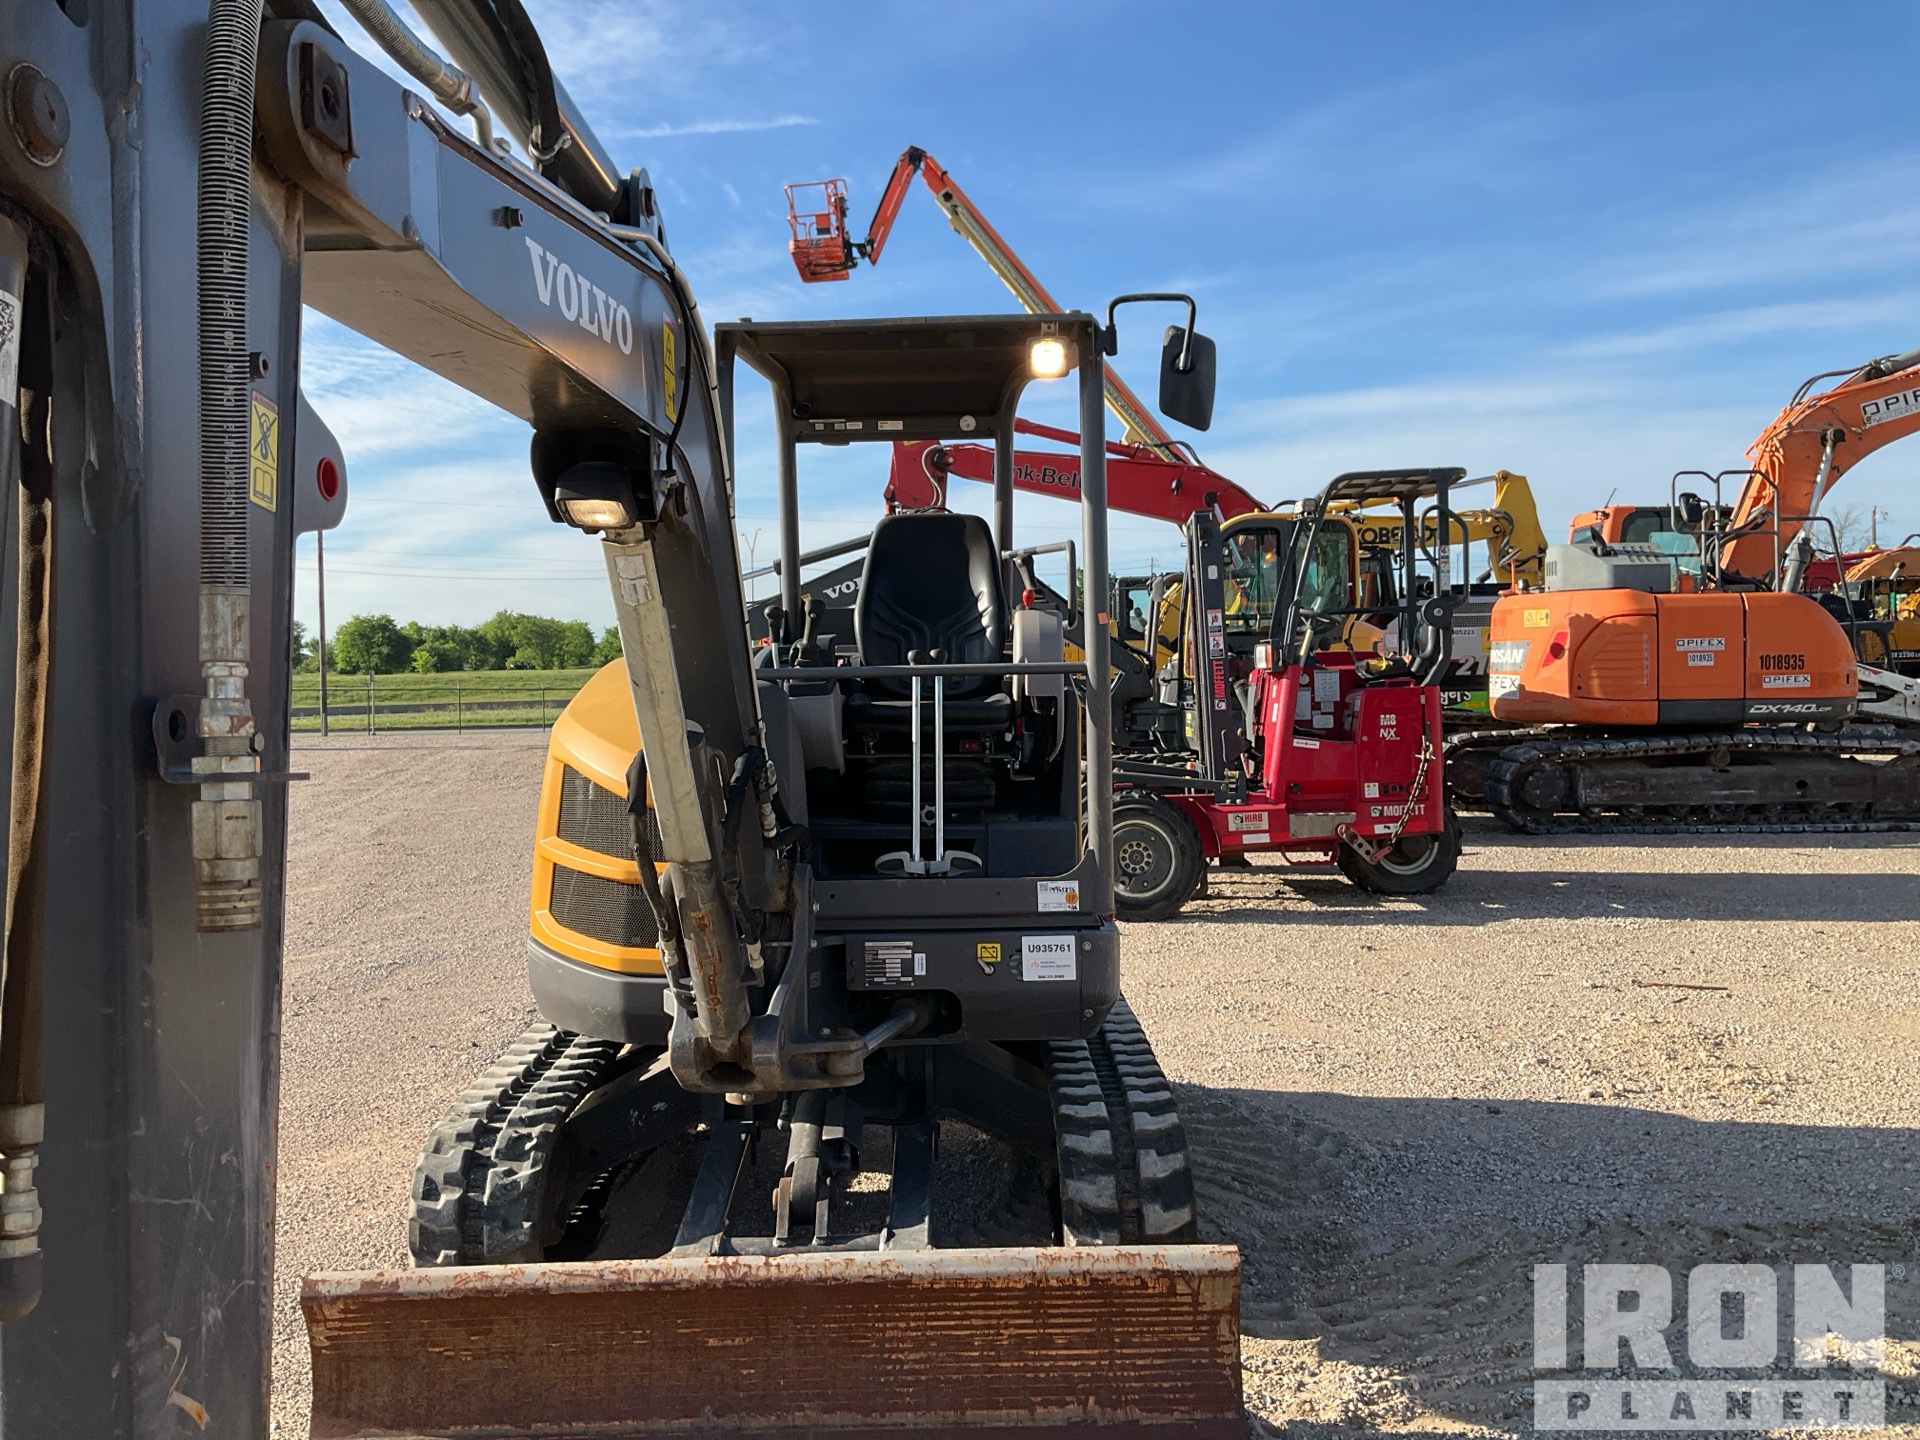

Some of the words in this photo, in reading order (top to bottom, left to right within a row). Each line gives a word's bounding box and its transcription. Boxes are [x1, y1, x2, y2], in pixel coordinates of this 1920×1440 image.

[525, 236, 633, 355] VOLVO
[1676, 639, 1724, 647] OPIFEX
[1688, 653, 1713, 662] 1018935
[1759, 654, 1805, 670] 1018935
[1455, 655, 1490, 676] 21
[1213, 660, 1226, 698] MOFFETT
[1763, 675, 1810, 684] OPIFEX
[1244, 813, 1263, 823] HIAB
[1028, 944, 1071, 953] U935761
